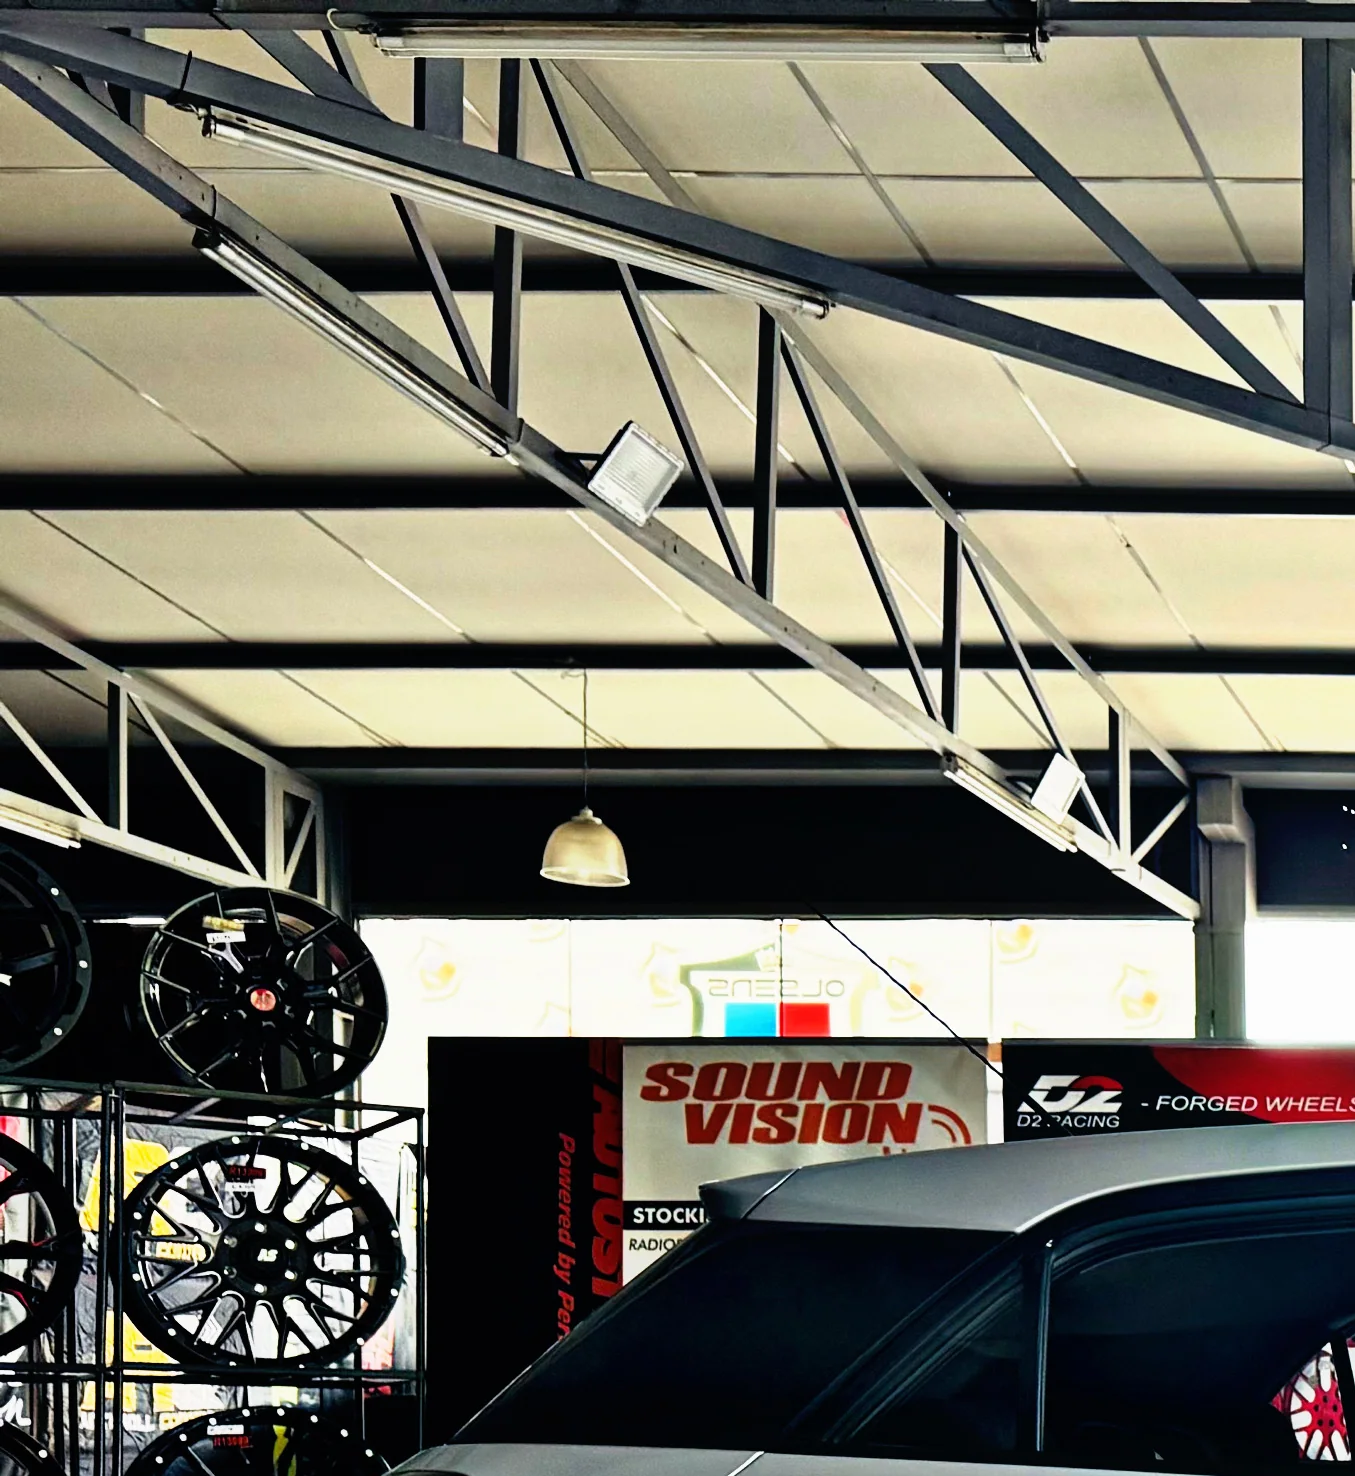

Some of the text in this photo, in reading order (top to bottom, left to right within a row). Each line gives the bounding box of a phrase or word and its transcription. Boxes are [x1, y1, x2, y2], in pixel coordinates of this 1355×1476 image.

[640, 1062, 912, 1101] SOUND
[1155, 1095, 1258, 1112] FORGED
[684, 1103, 923, 1144] VISION
[558, 1132, 575, 1248] Powered
[633, 1207, 708, 1224] STOCKI
[553, 1252, 575, 1284] by
